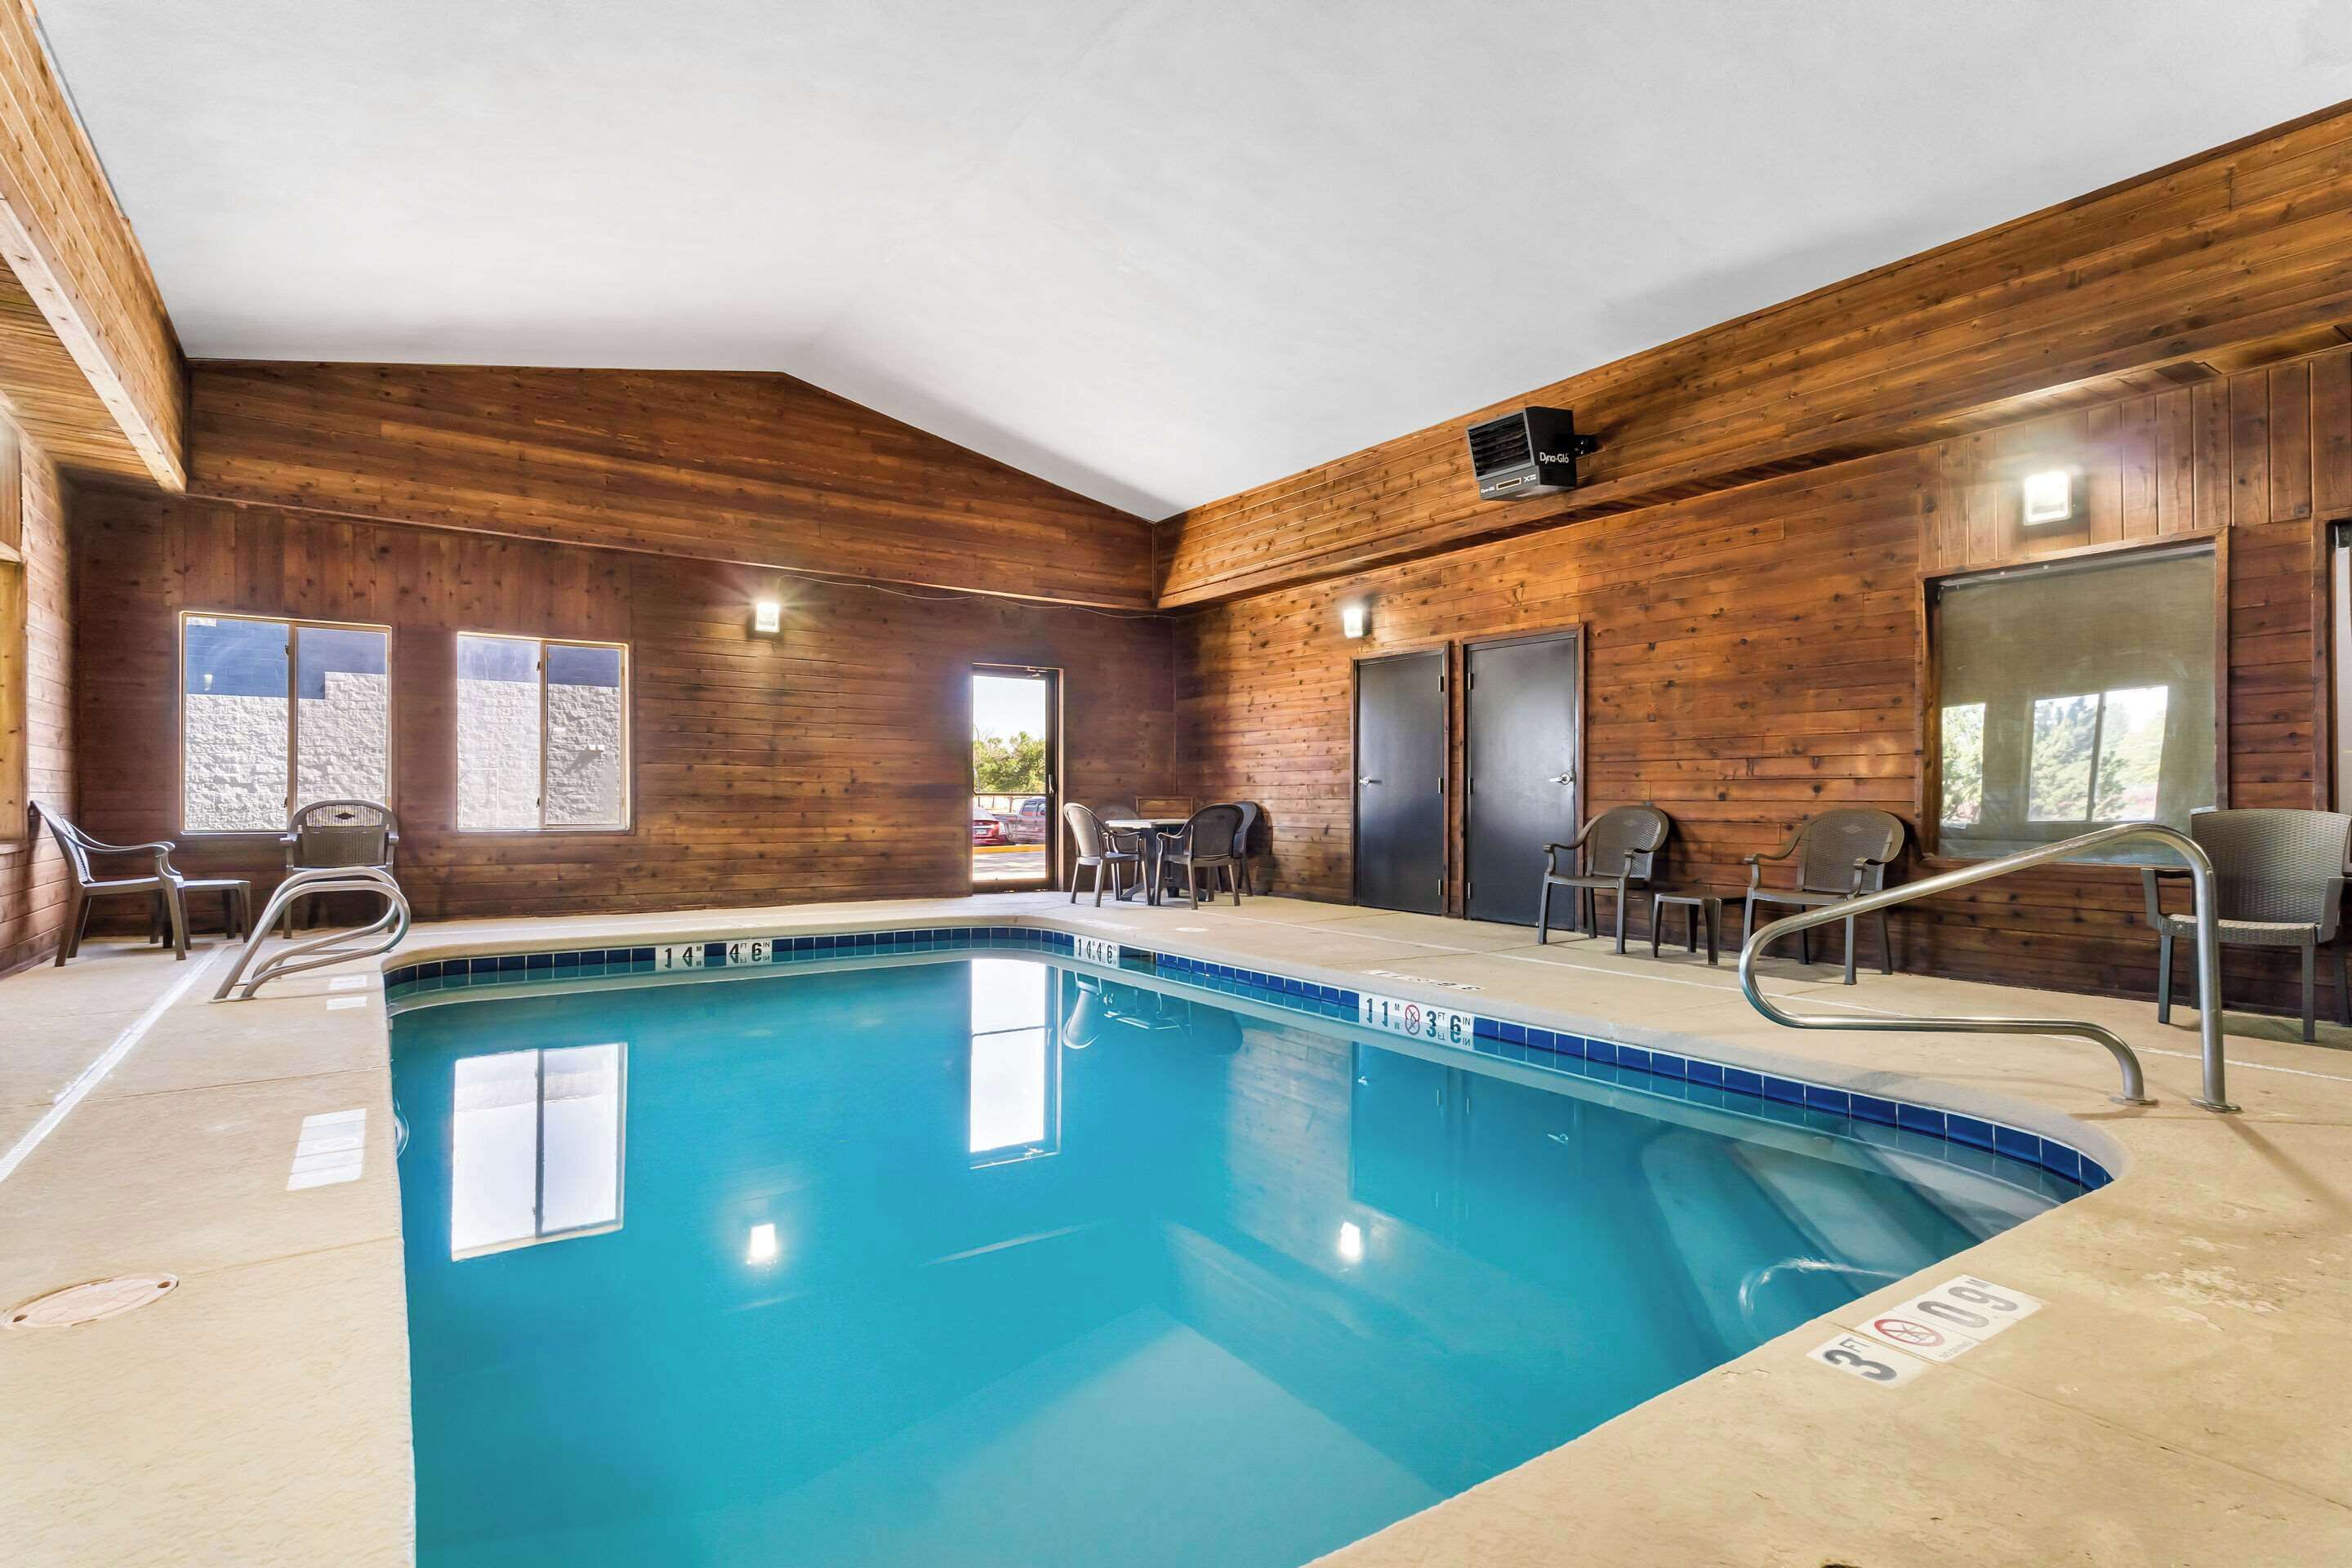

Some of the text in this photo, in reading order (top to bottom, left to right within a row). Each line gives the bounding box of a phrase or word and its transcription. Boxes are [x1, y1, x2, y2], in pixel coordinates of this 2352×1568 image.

[1539, 452, 1569, 465] Dyna-Glo
[751, 942, 762, 956] 6
[1437, 1012, 1446, 1021] FT
[1450, 1014, 1462, 1033] 6
[1463, 1016, 1471, 1027] IN
[1838, 1338, 1869, 1352] FT
[1823, 1349, 1897, 1381] 3
